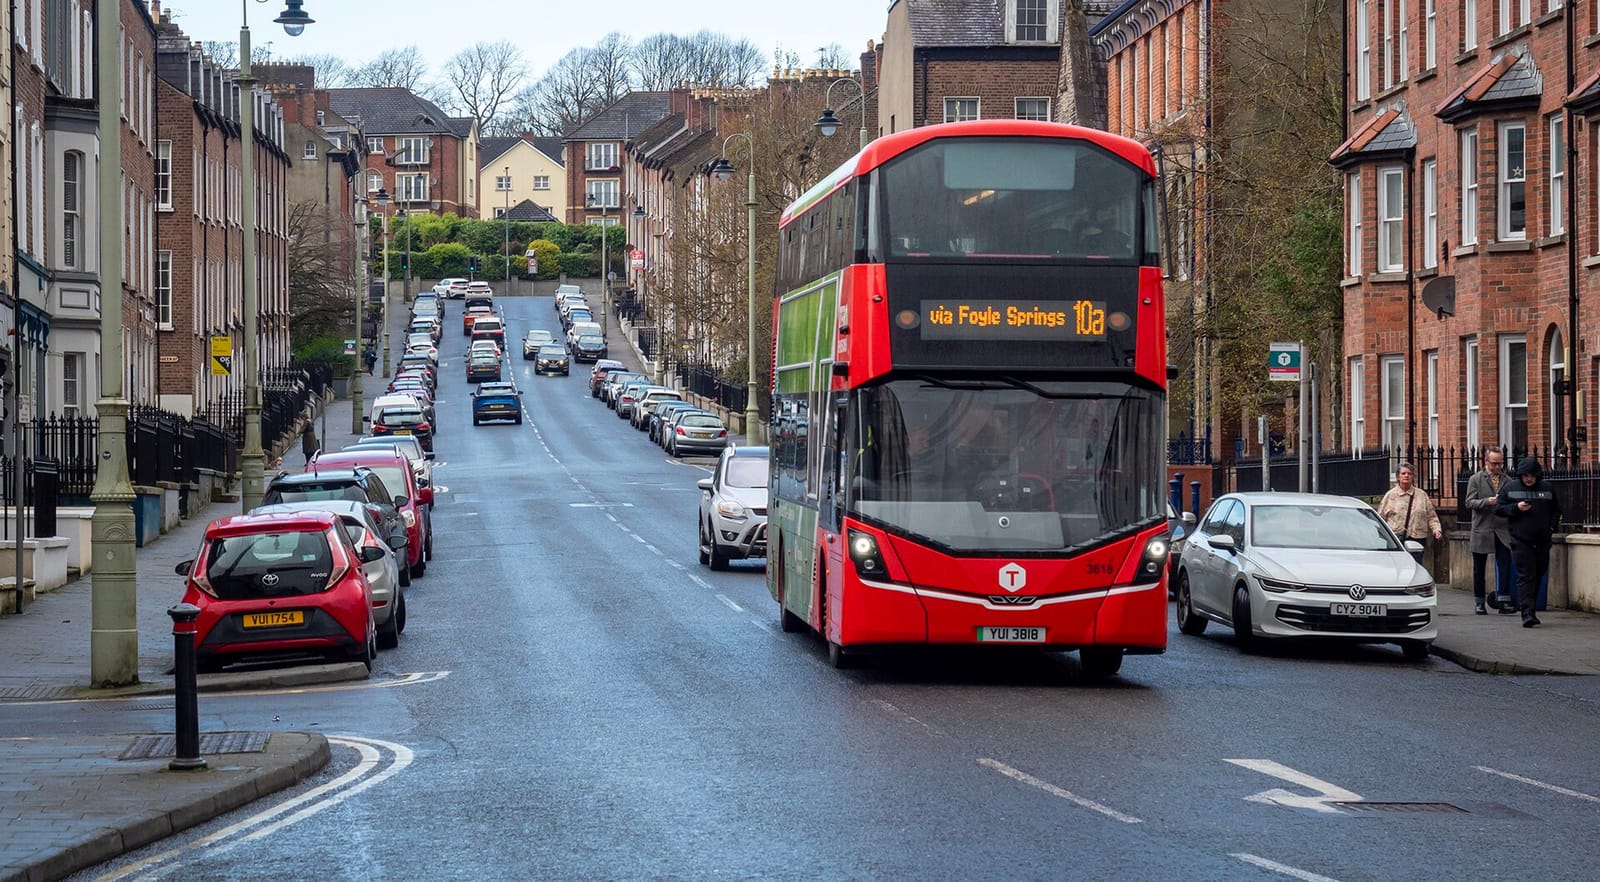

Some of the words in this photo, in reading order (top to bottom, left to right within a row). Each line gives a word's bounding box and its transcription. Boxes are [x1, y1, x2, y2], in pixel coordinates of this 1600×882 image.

[930, 305, 953, 325] via
[958, 305, 1000, 327] Foyle
[1006, 306, 1066, 327] Springs
[1073, 300, 1105, 335] 10a
[1281, 355, 1288, 364] T
[1005, 571, 1019, 586] T
[1336, 604, 1356, 614] CYZ
[1359, 605, 1381, 615] 9041
[252, 615, 268, 625] VUI
[271, 613, 295, 623] 1754
[990, 628, 1008, 640] YUI
[1012, 628, 1038, 640] 3818
